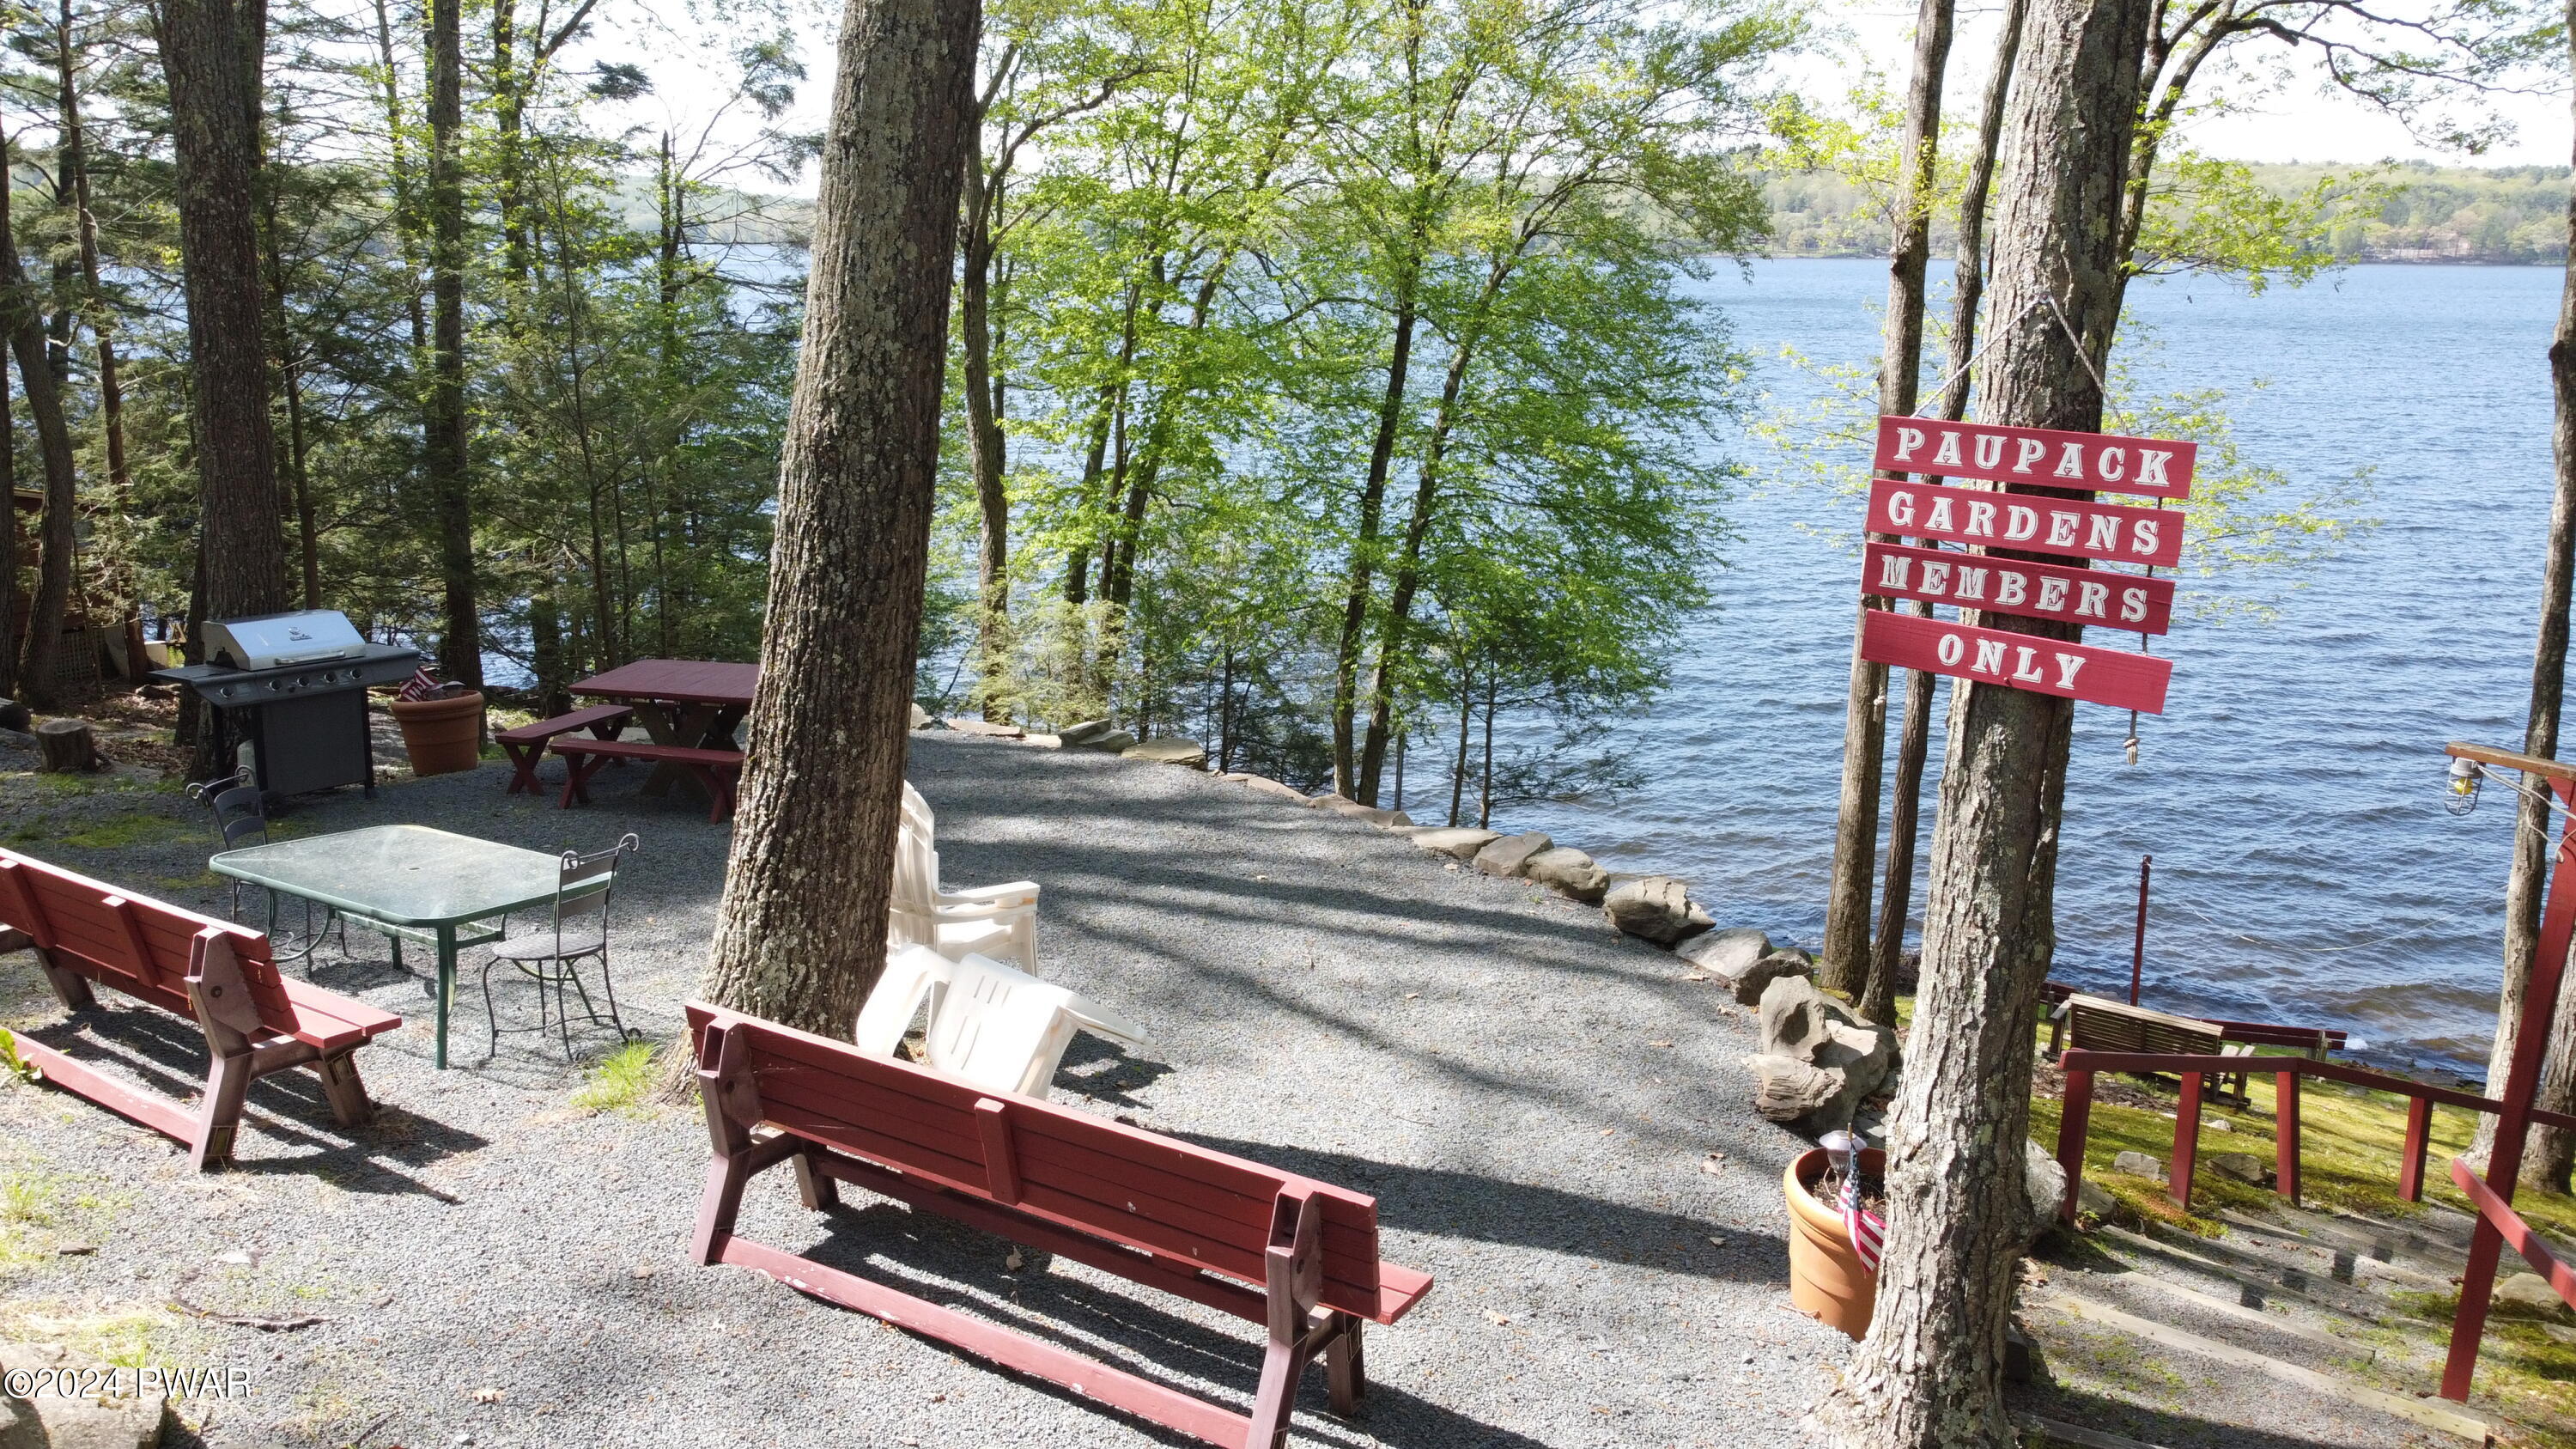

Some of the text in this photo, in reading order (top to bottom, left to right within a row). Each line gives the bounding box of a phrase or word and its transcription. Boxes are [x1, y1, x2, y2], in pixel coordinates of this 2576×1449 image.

[1893, 427, 2173, 487] PAUPACK
[1888, 490, 2160, 555] GARDENS
[1879, 555, 2148, 623] MEMBERS
[1937, 634, 2087, 690] ONLY
